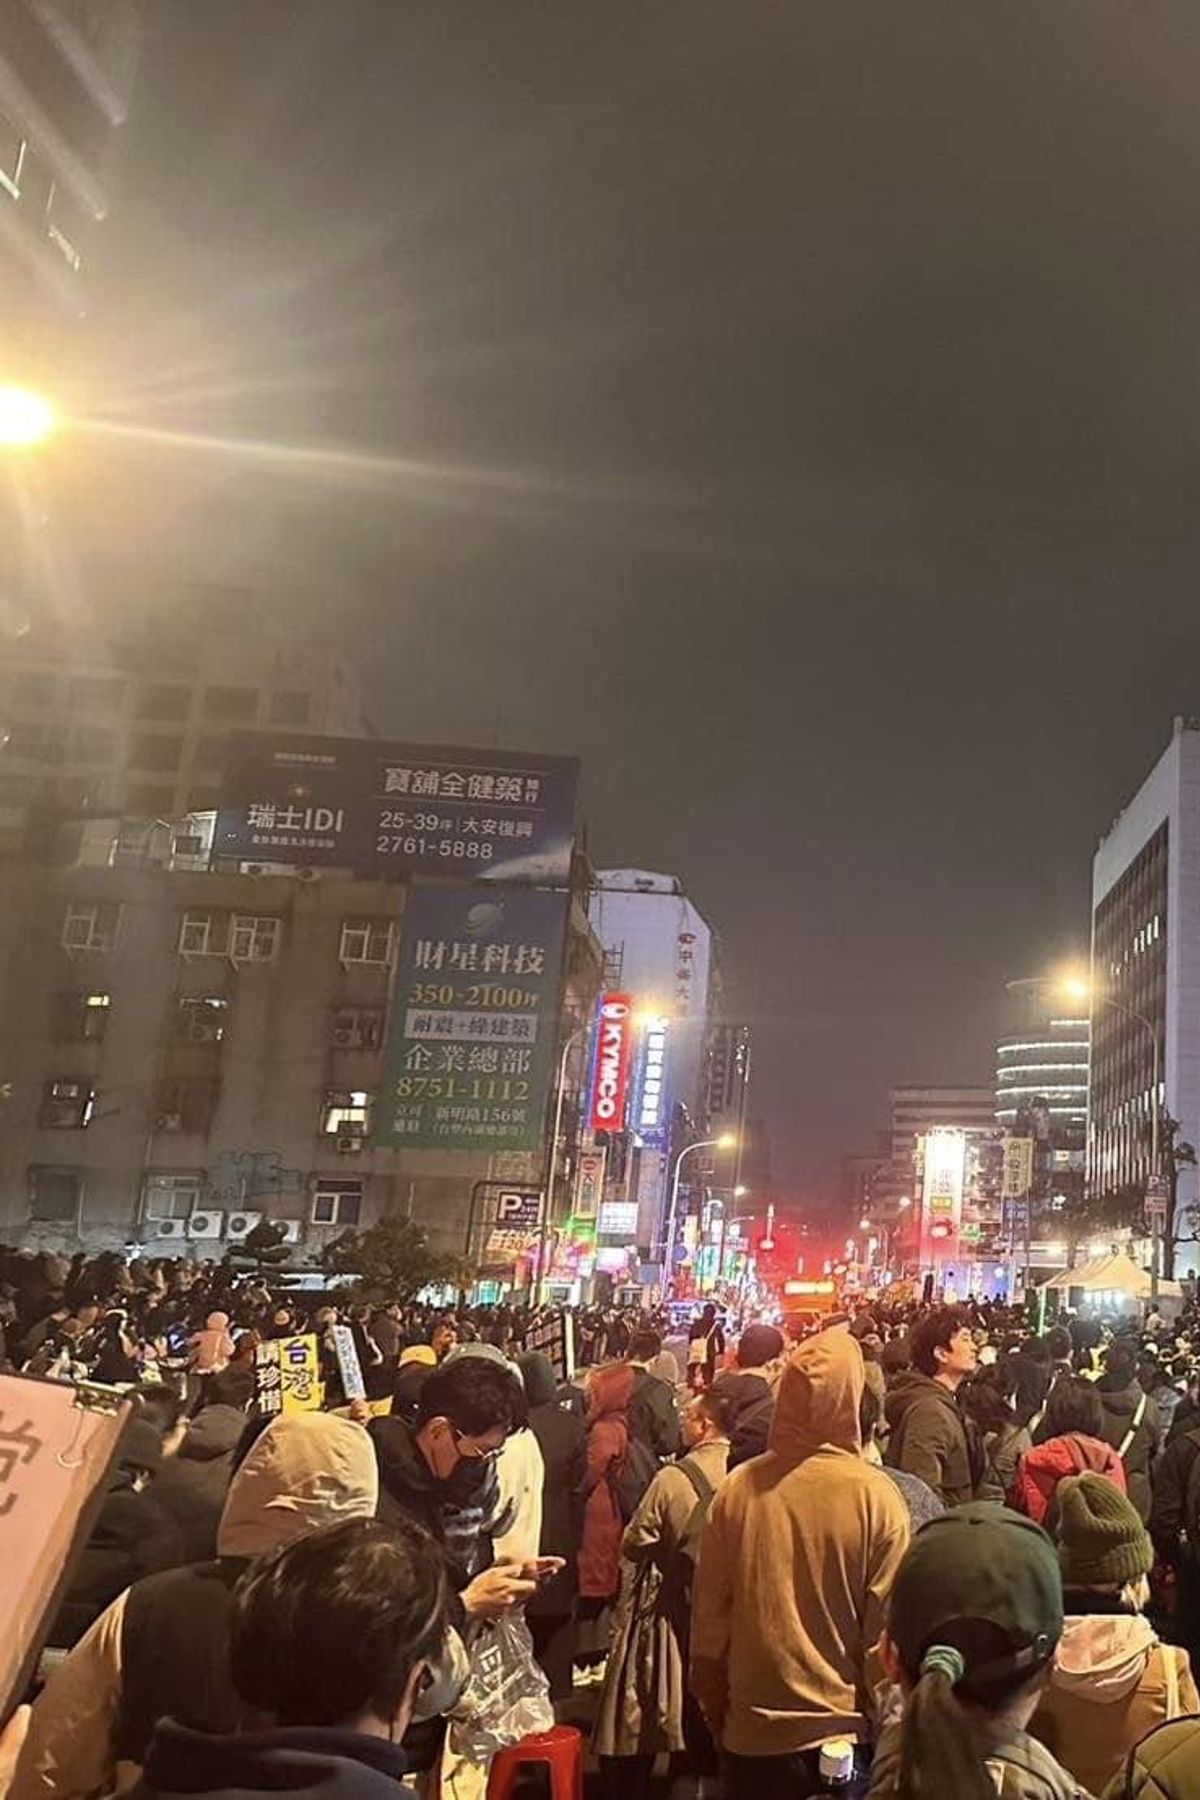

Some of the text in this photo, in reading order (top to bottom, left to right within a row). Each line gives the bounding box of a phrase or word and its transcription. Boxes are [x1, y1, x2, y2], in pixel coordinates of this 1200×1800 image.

[246, 803, 344, 832] 瑞士IDI
[376, 835, 493, 859] 2761-5888
[415, 940, 546, 975] 財星科技
[404, 1043, 532, 1074] 企業總部
[596, 1023, 624, 1119] KYMCO
[396, 1077, 530, 1101] 8751-1112
[498, 1194, 523, 1220] P
